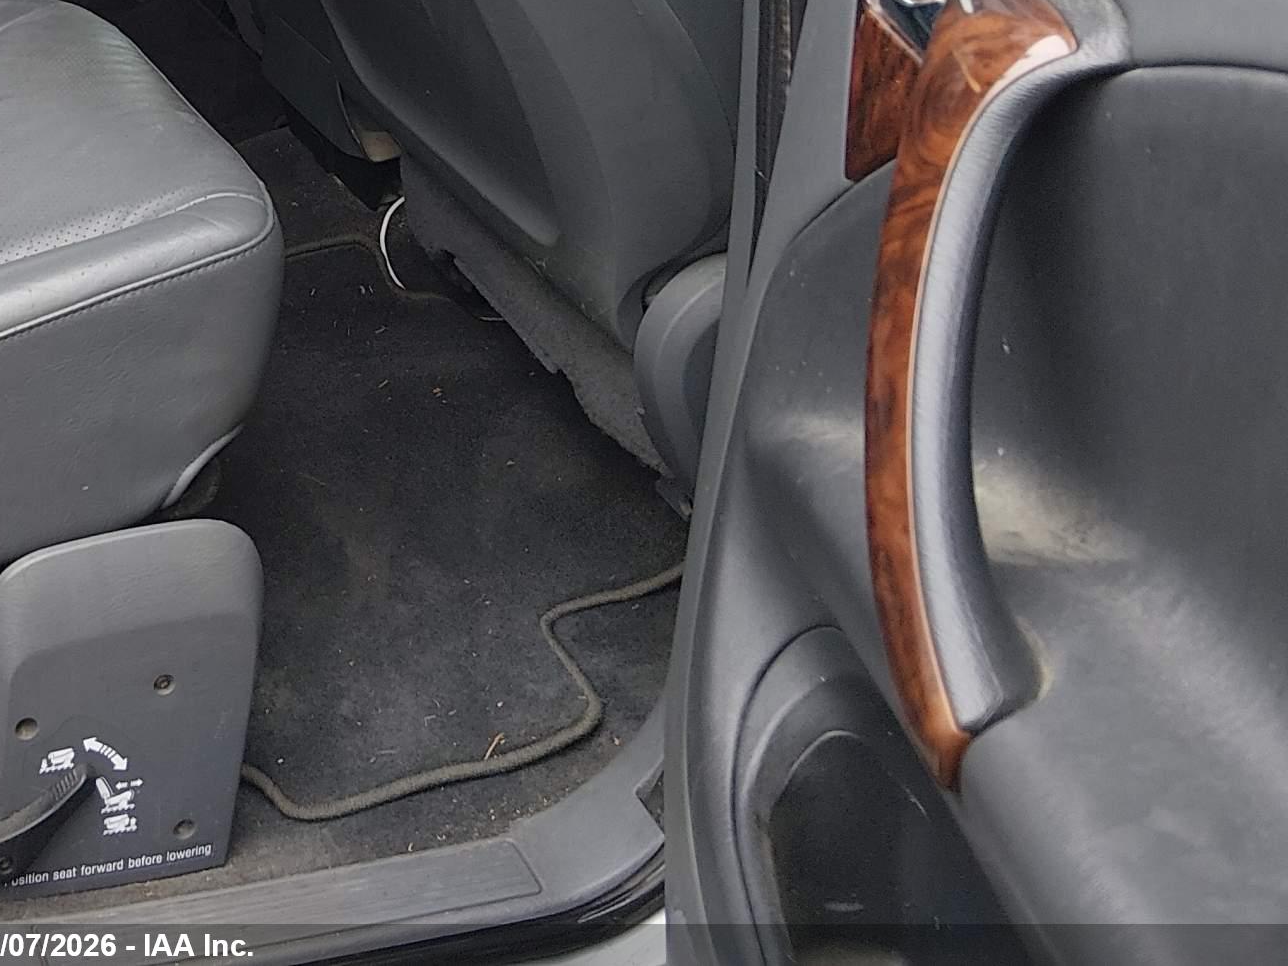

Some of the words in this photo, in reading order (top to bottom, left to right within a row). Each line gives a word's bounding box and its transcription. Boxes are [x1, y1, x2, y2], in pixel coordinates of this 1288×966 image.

[5, 872, 49, 887] osition
[53, 866, 77, 880] seat
[81, 859, 124, 876] forward
[128, 852, 163, 869] before
[166, 843, 212, 862] lowering
